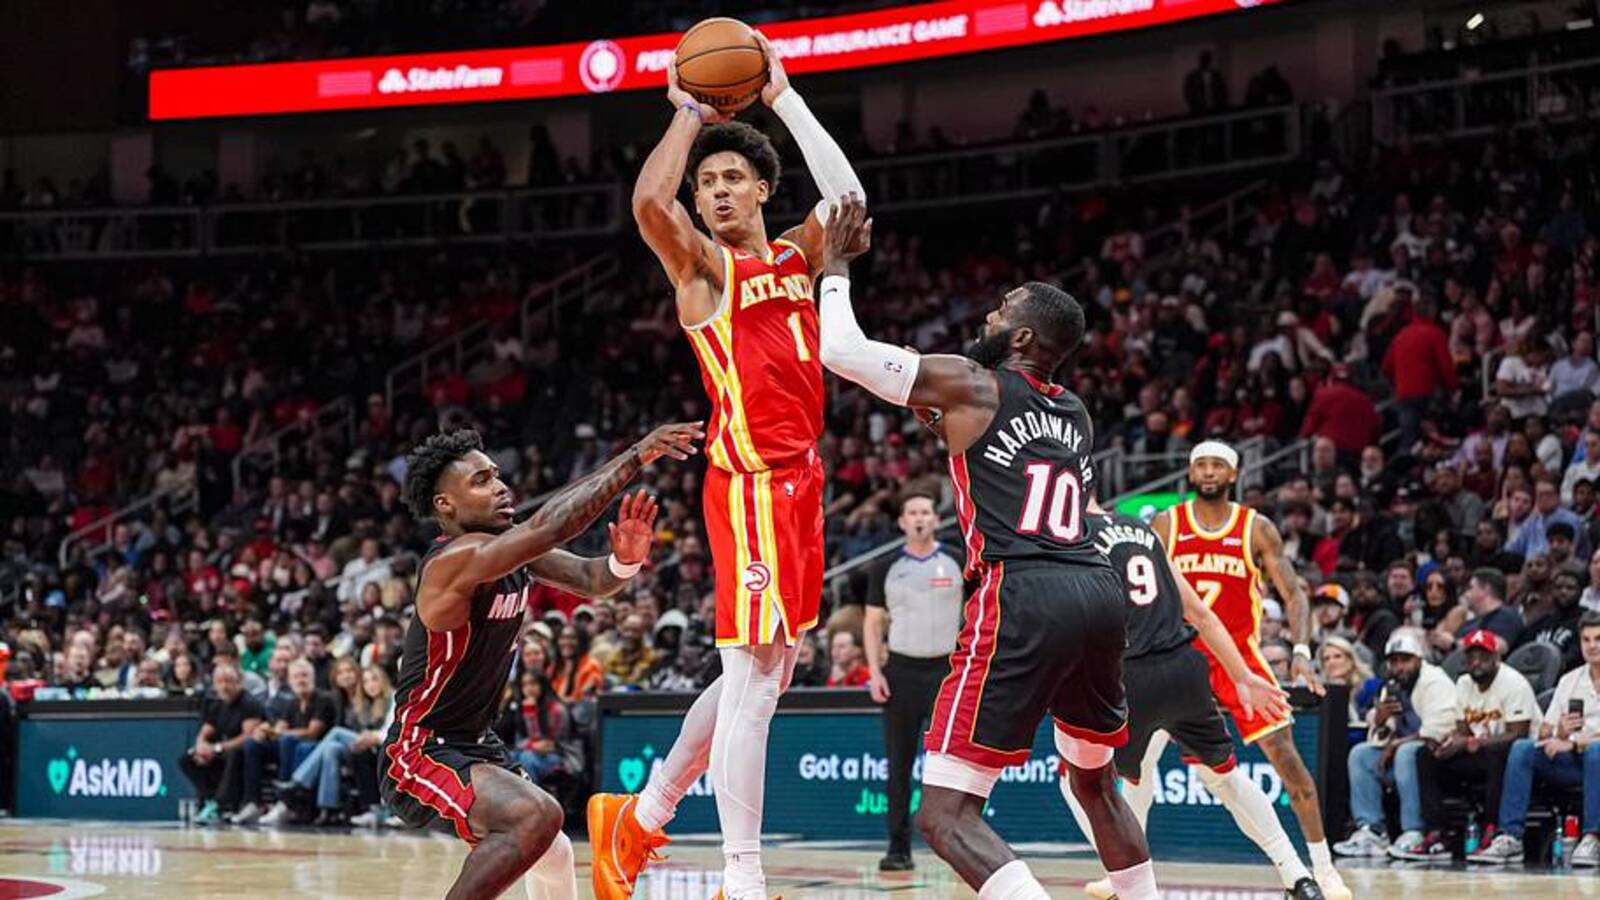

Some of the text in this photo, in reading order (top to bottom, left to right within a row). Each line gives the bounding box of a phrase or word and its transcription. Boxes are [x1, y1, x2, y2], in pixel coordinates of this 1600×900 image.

[772, 14, 968, 58] OUR INSURANCE GAME
[787, 311, 811, 362] 1
[984, 411, 1083, 467] HARDAWAY
[1018, 460, 1082, 542] 10
[1094, 525, 1155, 554] LARSSON
[1126, 555, 1158, 606] 9
[1196, 580, 1222, 609] 7
[800, 754, 839, 780] Got
[842, 757, 859, 781] a
